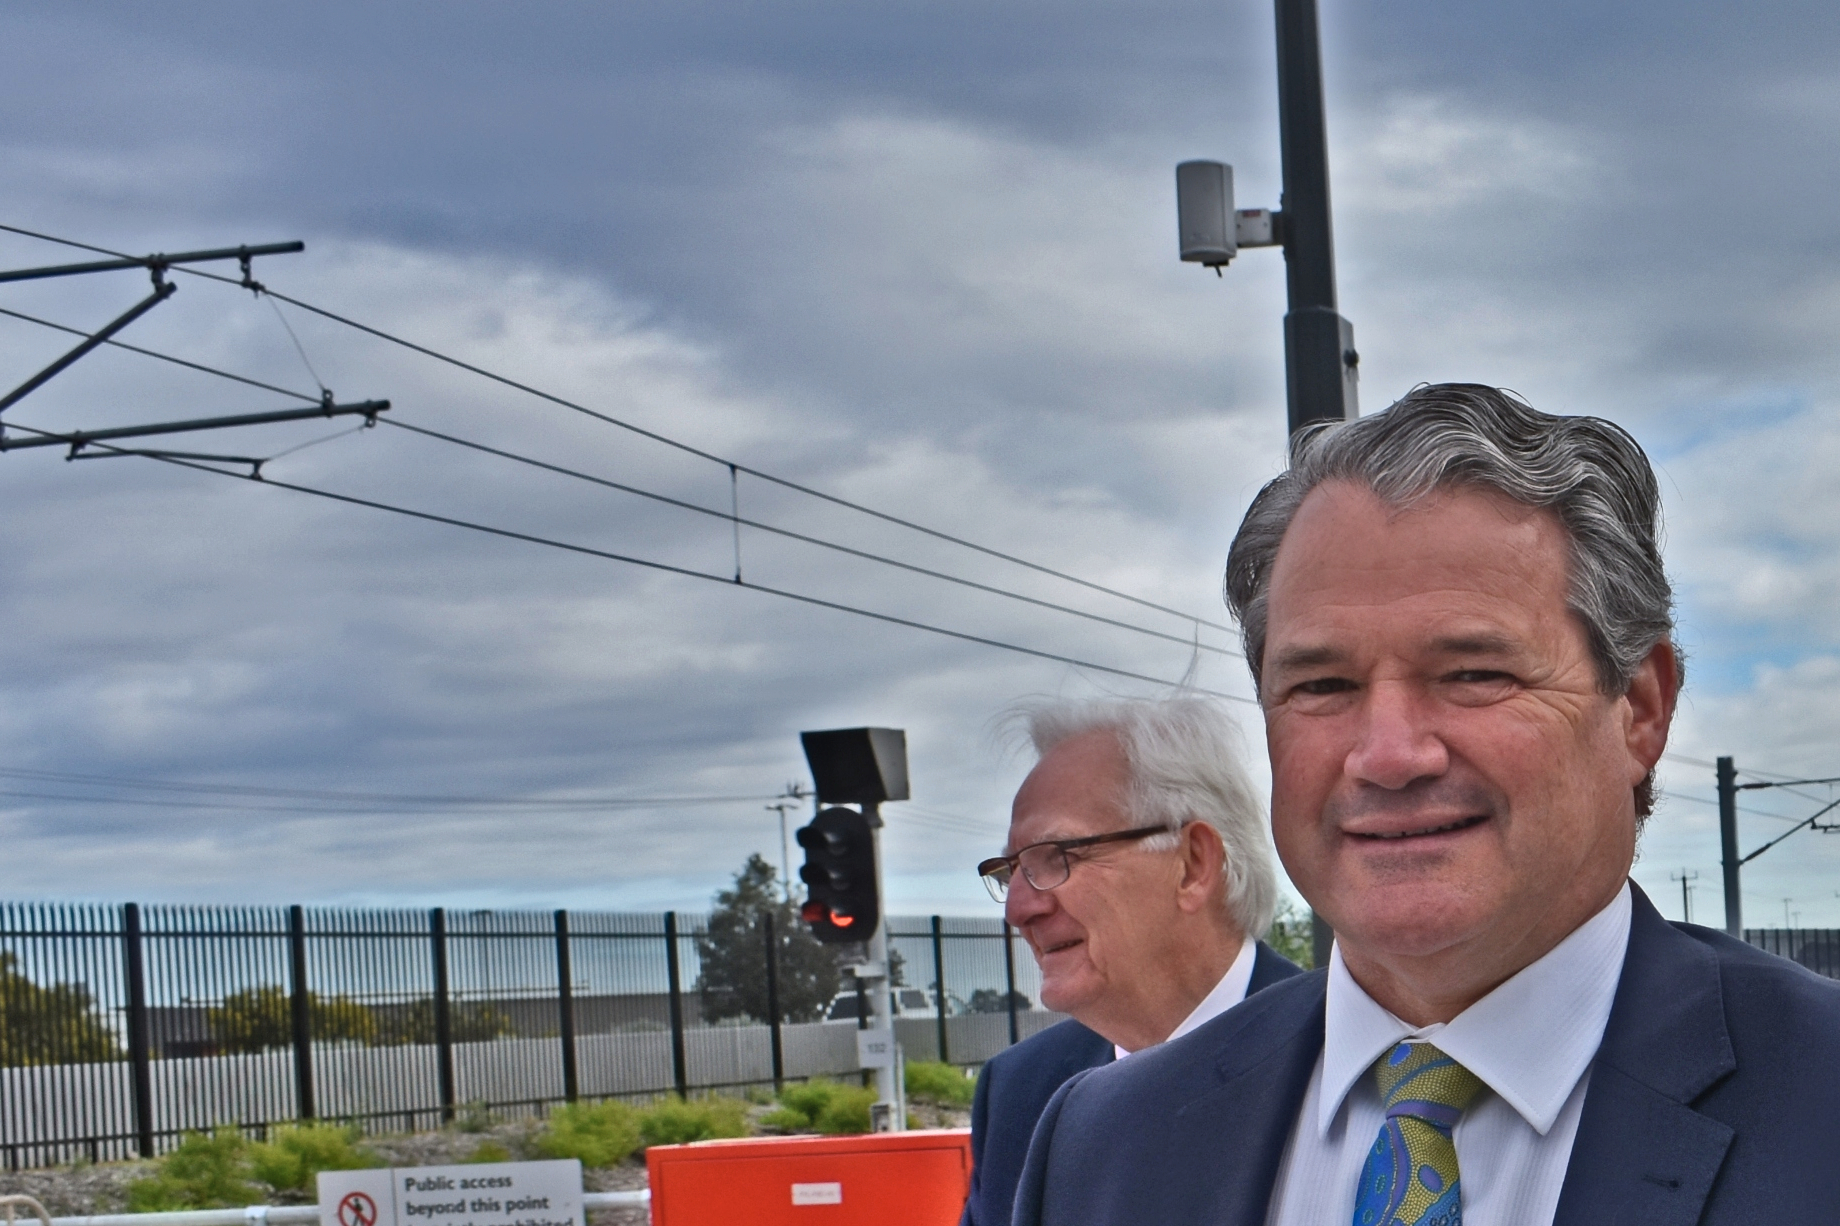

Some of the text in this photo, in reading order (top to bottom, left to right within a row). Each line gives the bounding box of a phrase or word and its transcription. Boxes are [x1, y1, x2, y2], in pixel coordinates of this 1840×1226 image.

[405, 1175, 512, 1192] Public access
[406, 1196, 549, 1219] beyond this point
